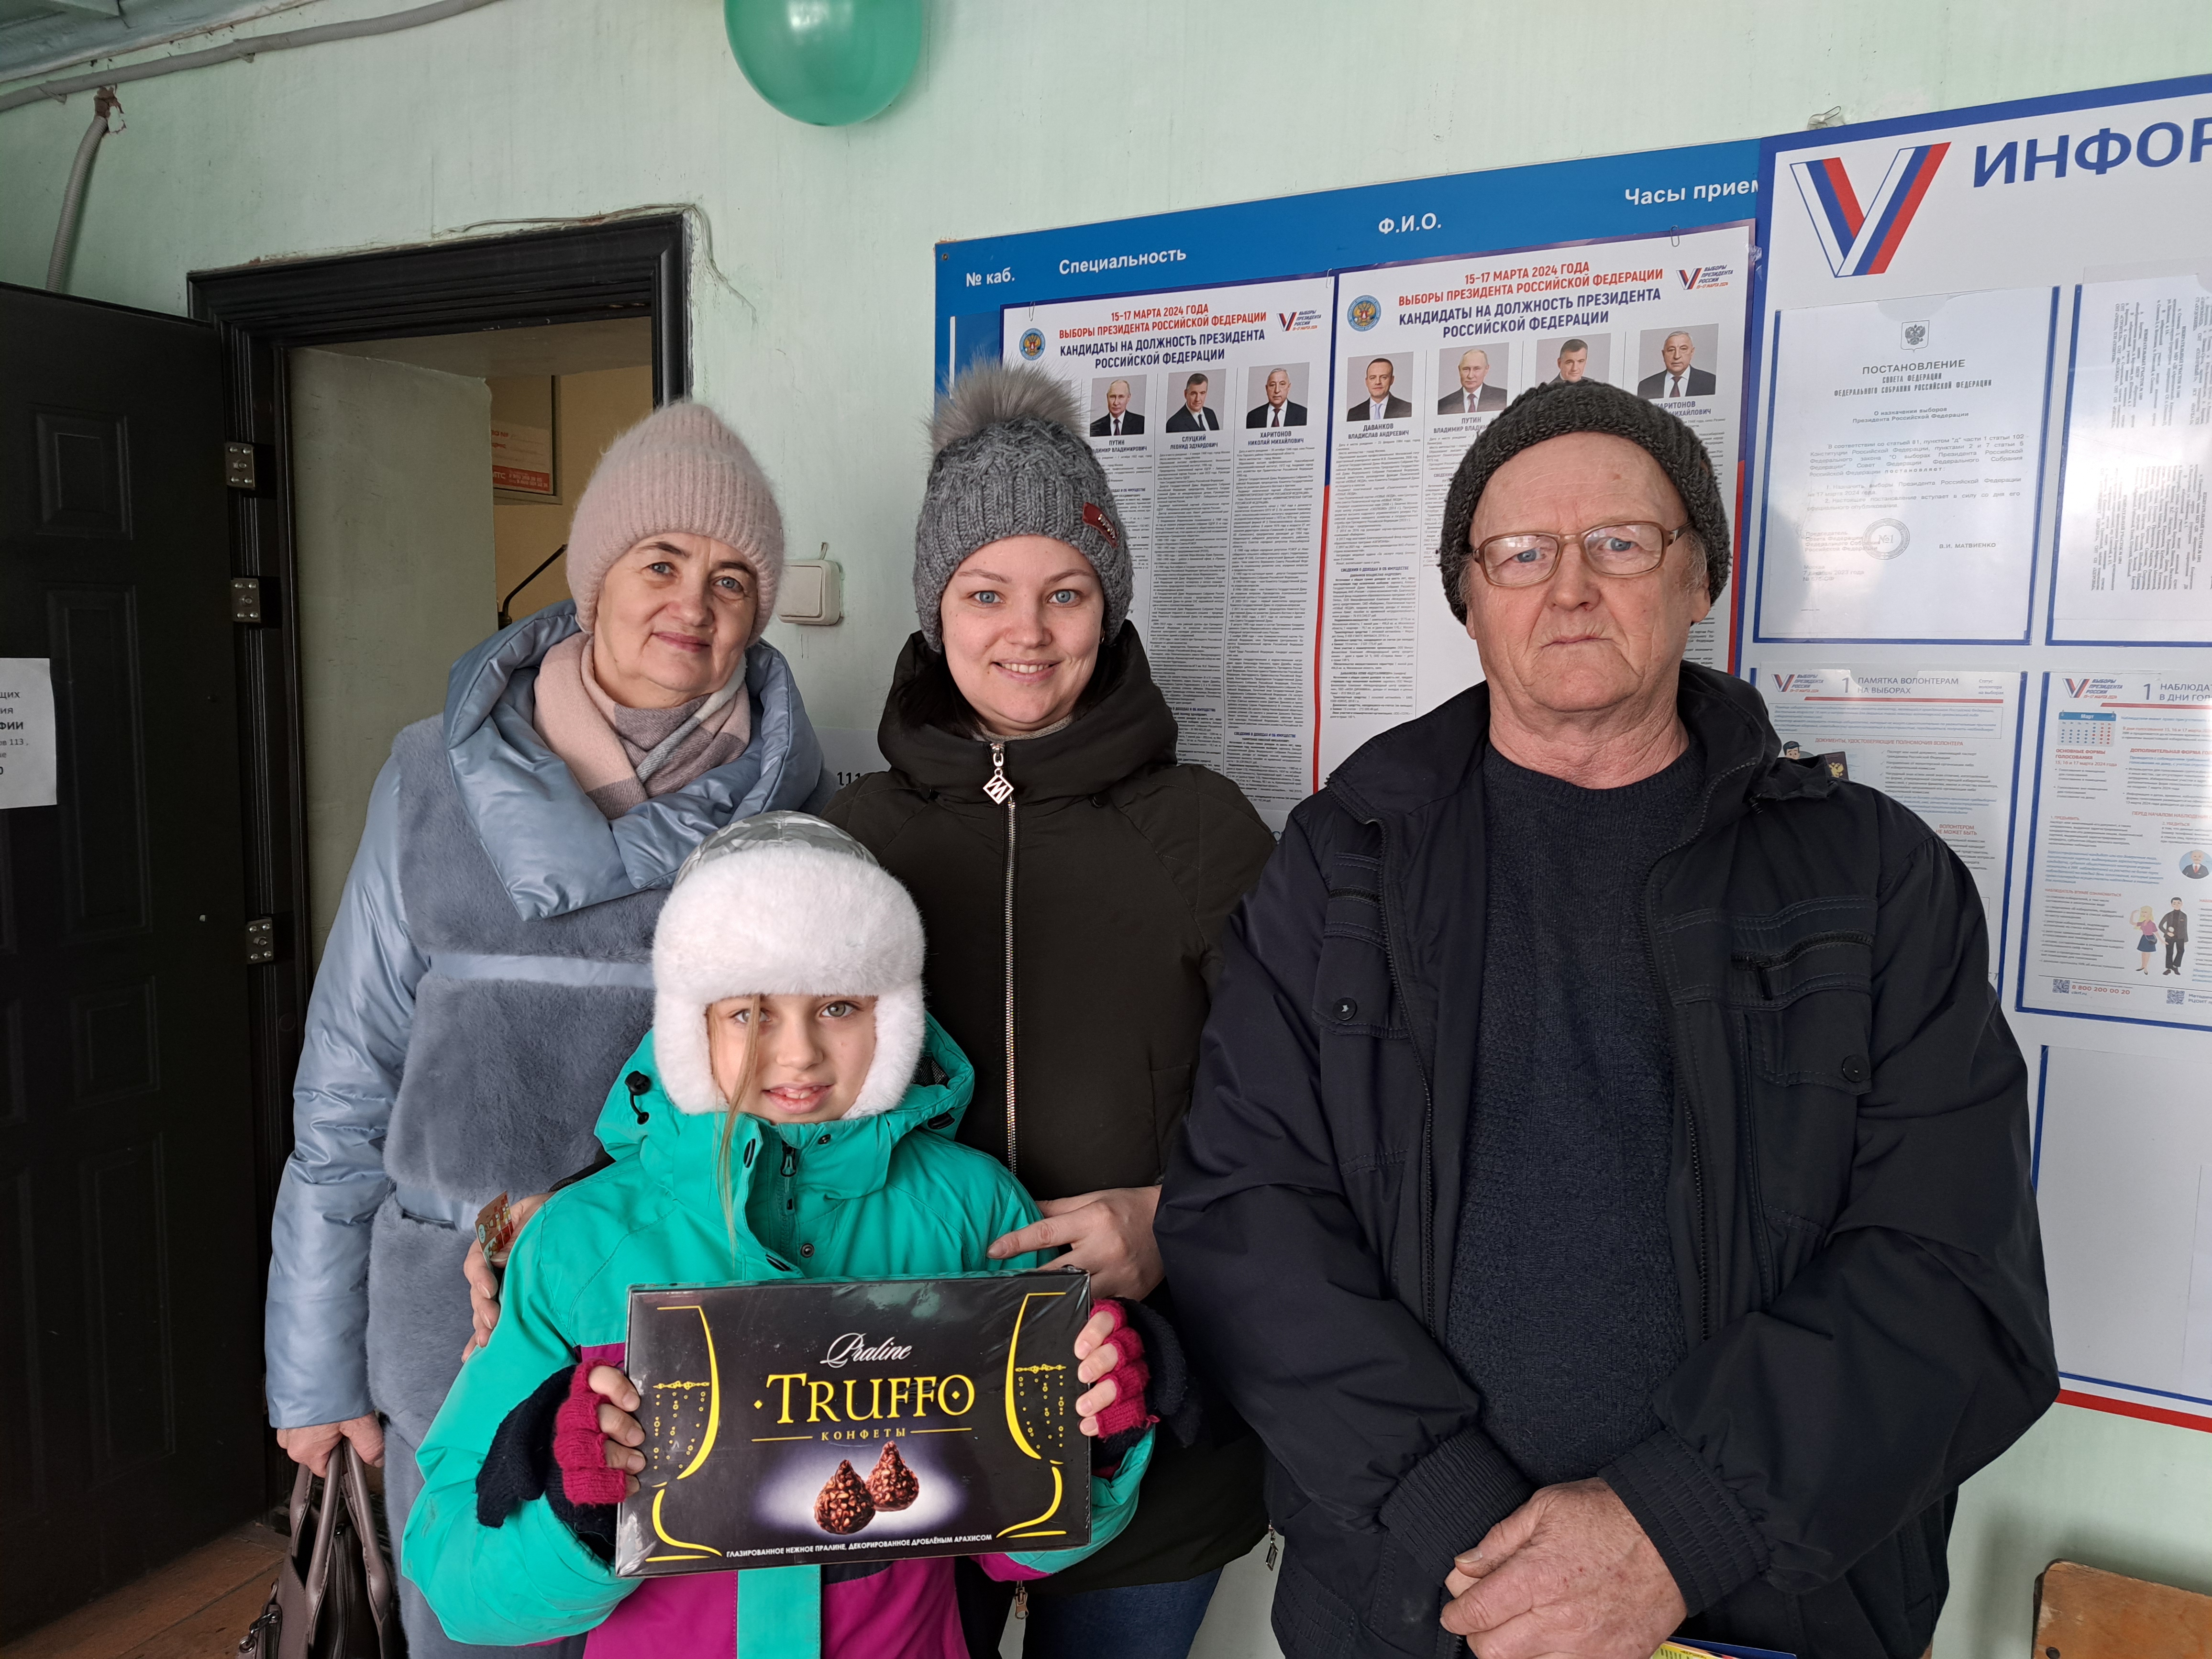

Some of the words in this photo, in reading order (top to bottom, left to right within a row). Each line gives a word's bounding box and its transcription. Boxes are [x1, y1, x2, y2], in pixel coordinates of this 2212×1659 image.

[1626, 188, 1685, 204] Часы
[1379, 213, 1441, 233] Ф.И.О.
[1060, 250, 1186, 274] Специальность
[966, 272, 982, 287] №
[987, 267, 1015, 284] каб.
[1465, 272, 1490, 284] 15-17
[1493, 268, 1529, 281] МАРТА
[1532, 265, 1559, 278] 2024
[1561, 262, 1589, 275] ГОДА
[1399, 292, 1443, 306] ВЫБОРЫ
[1447, 285, 1513, 300] ПРЕЗИДЕНТА
[1517, 276, 1589, 293] РОССИЙСКОЙ
[1593, 269, 1662, 286] ФЕДЕРАЦИИ
[1112, 311, 1131, 321] 15-17
[1134, 309, 1161, 319] МАРТА
[1163, 306, 1184, 318] 2024
[1186, 304, 1208, 316] ГОДА
[1400, 308, 1471, 325] КАНДИДАТЫ
[1476, 305, 1491, 317] НА
[1494, 297, 1573, 317] ДОЛЖНОСТЬ
[1577, 288, 1660, 307] ПРЕЗИДЕНТА
[1060, 328, 1095, 338] ВЫБОРЫ
[1098, 323, 1150, 335] ПРЕЗИДЕНТА
[1152, 316, 1208, 330] РОССИЙСКОЙ
[1212, 312, 1266, 326] ФЕДЕРАЦИИ
[1443, 319, 1525, 337] РОССИЙСКОЙ
[1529, 311, 1608, 330] ФЕДЕРАЦИИ
[1061, 342, 1117, 356] КАНДИДАТЫ
[1121, 341, 1133, 351] НА
[1136, 335, 1196, 351] ДОЛЖНОСТЬ
[1200, 330, 1264, 344] ПРЕЗИДЕНТА
[1095, 352, 1159, 368] РОССИЙСКОЙ
[1163, 349, 1224, 364] ФЕДЕРАЦИИ
[1863, 360, 1965, 374] ПОСТАНОВЛЕНИЕ
[1908, 373, 1941, 382] ФЕДЕРАЦИИ
[1835, 387, 1877, 396] ФЕДЕРАЛЬНОГО
[1881, 385, 1910, 393] СОБРАНИЯ
[1914, 381, 1951, 390] РОССИЙСКОЙ
[1956, 380, 1991, 388] ФЕДЕРАЦИИ
[1363, 423, 1394, 431] ДАВАНКОВ
[1248, 437, 1270, 445] НИКОЛАЙ
[1841, 677, 1849, 694] 1
[2144, 683, 2150, 700] 1
[819, 1333, 913, 1368] Praline
[765, 1373, 975, 1425] TRUFFO
[821, 1427, 906, 1441] КОНФЕТЫ
[727, 1548, 784, 1557] ГЛАЗИРОВАННОЕ
[849, 1540, 910, 1549] ДЕКОРИРОВАННОЕ
[911, 1537, 952, 1546] ДРОБЛЁНЫМ
